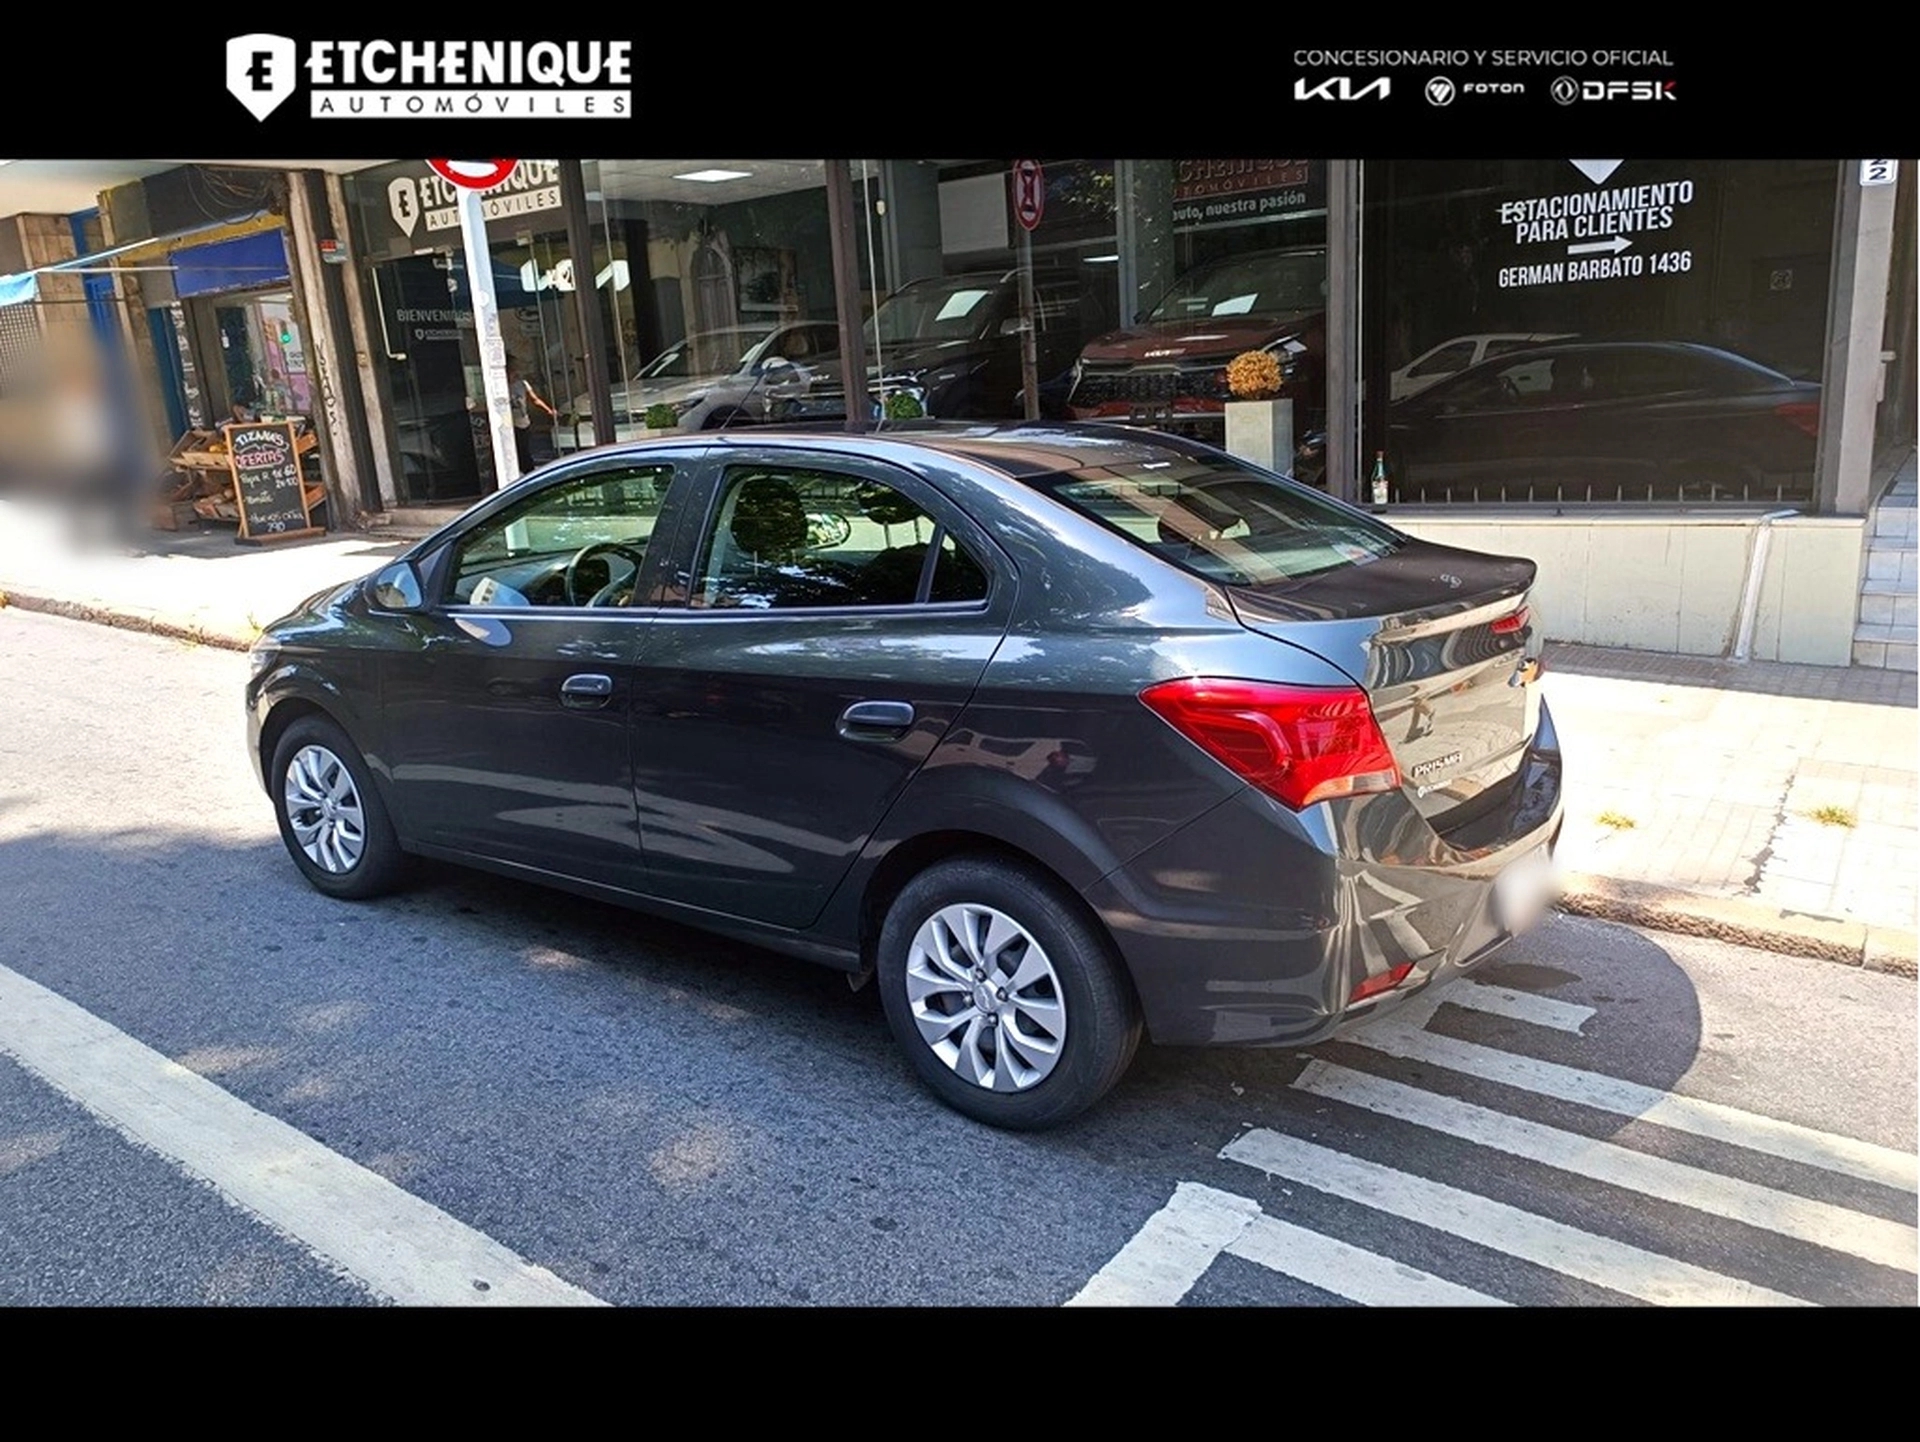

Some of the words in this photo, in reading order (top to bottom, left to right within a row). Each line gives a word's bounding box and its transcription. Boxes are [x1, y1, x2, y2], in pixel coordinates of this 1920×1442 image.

[1205, 199, 1257, 217] nuestra
[1260, 190, 1307, 213] pasión
[1501, 180, 1694, 225] ESTACIONAMIENTO
[1515, 218, 1569, 245] PARA
[1574, 206, 1673, 238] CLIENTES
[1499, 262, 1564, 288] GERMAN
[1567, 255, 1643, 282] BARBATO
[1649, 250, 1692, 275] 1436
[1411, 750, 1463, 778] PRISMA
